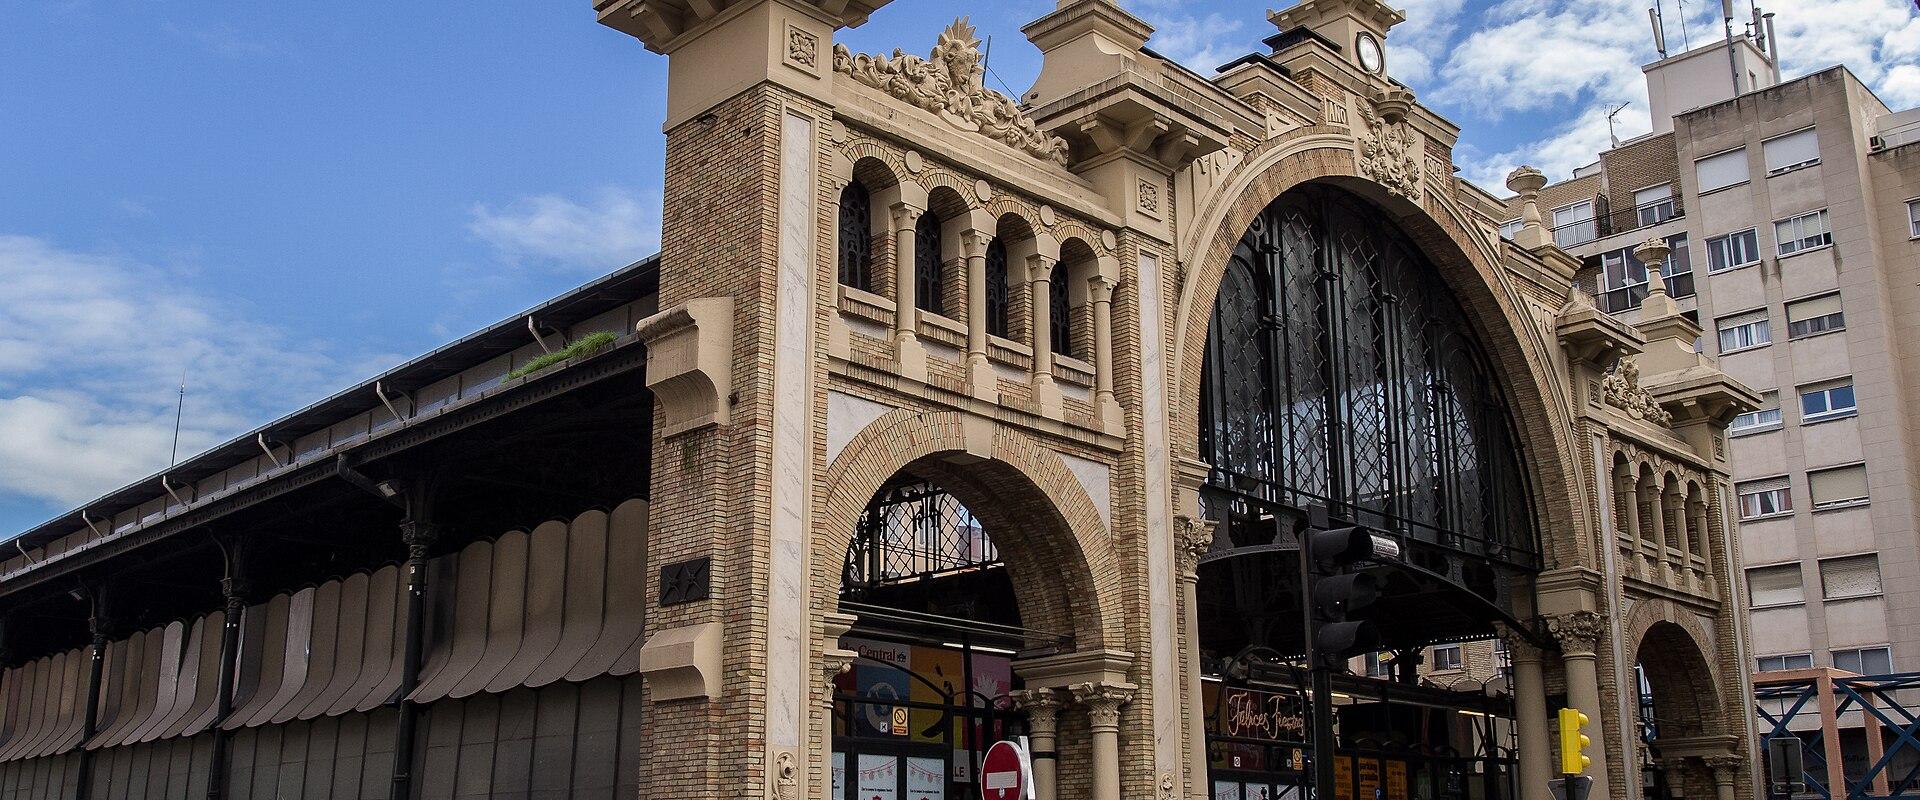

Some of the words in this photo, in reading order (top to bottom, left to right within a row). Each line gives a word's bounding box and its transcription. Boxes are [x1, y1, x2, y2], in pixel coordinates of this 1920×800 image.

[1424, 156, 1443, 181] 1903
[858, 644, 896, 662] Central
[1228, 691, 1270, 736] Felices
